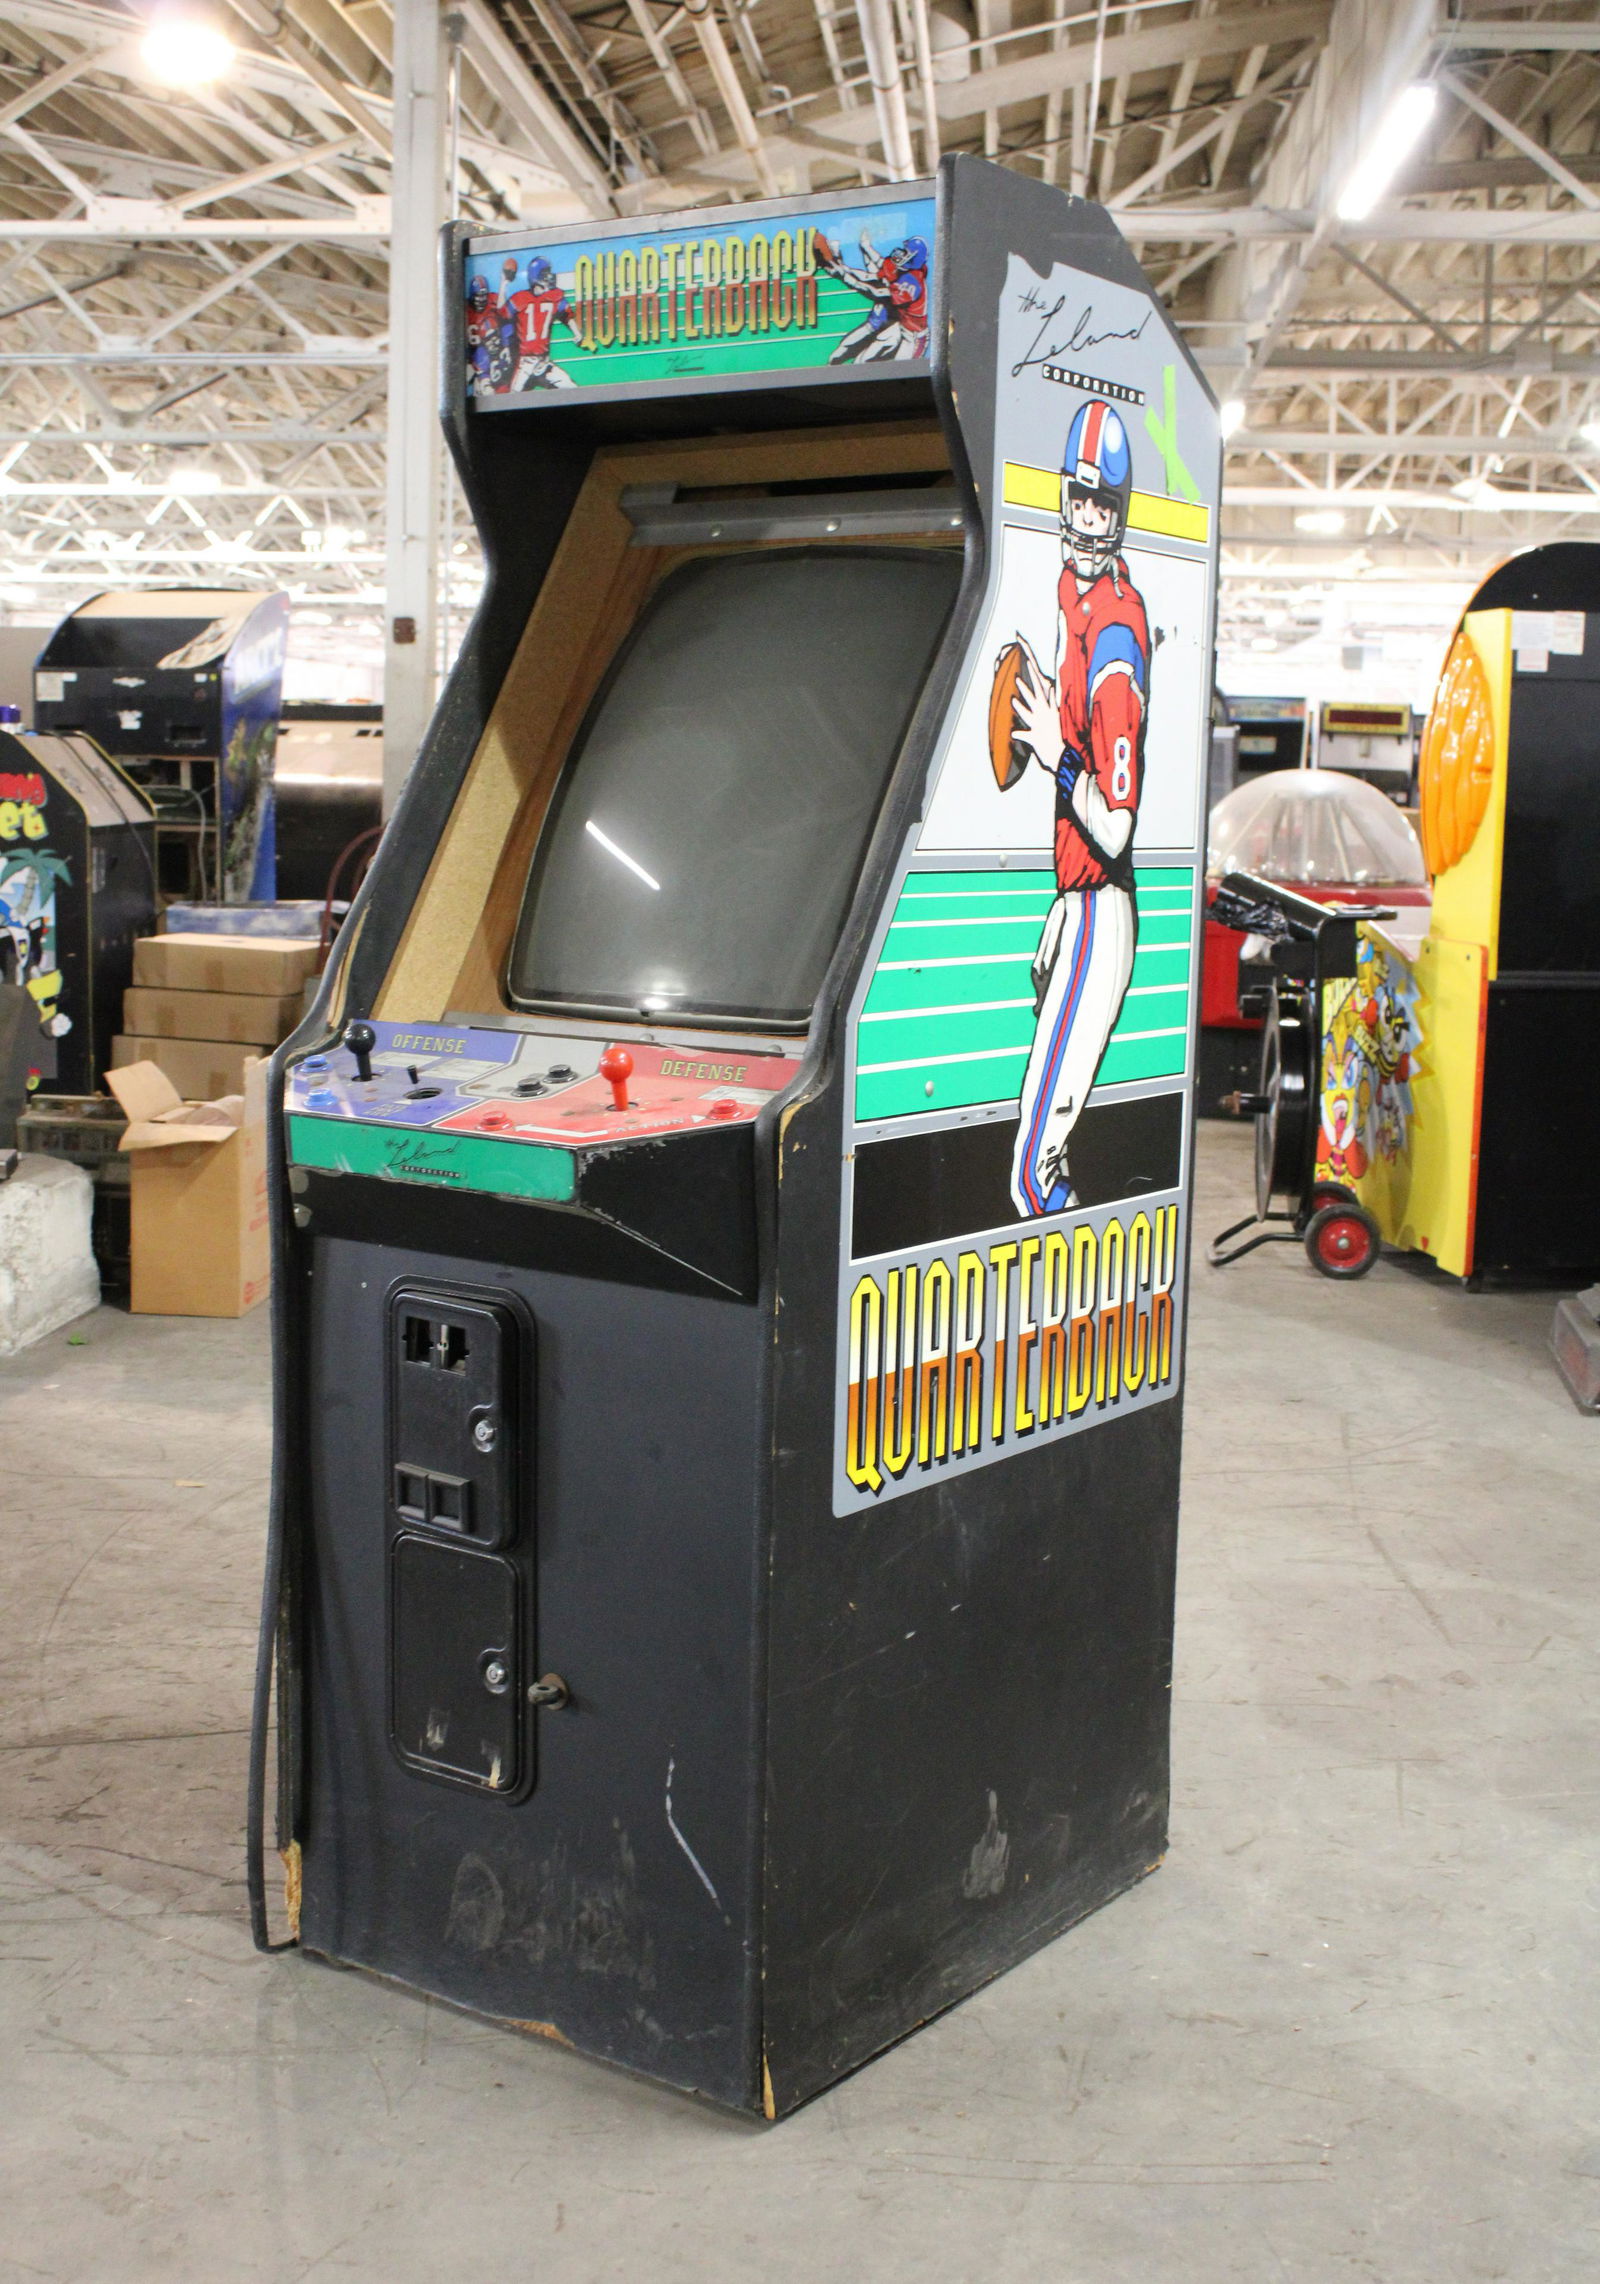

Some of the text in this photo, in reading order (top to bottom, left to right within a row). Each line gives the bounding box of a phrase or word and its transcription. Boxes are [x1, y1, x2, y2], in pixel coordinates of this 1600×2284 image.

[574, 226, 818, 354] QUARTERBACK
[524, 302, 554, 342] 17
[1012, 294, 1152, 377] Leland
[1042, 364, 1145, 406] CORPORATION
[1112, 736, 1131, 801] 8
[391, 1033, 468, 1055] OFFENSE
[660, 1059, 748, 1083] DEFENSE
[845, 1203, 1179, 1497] QUARTERBACK
